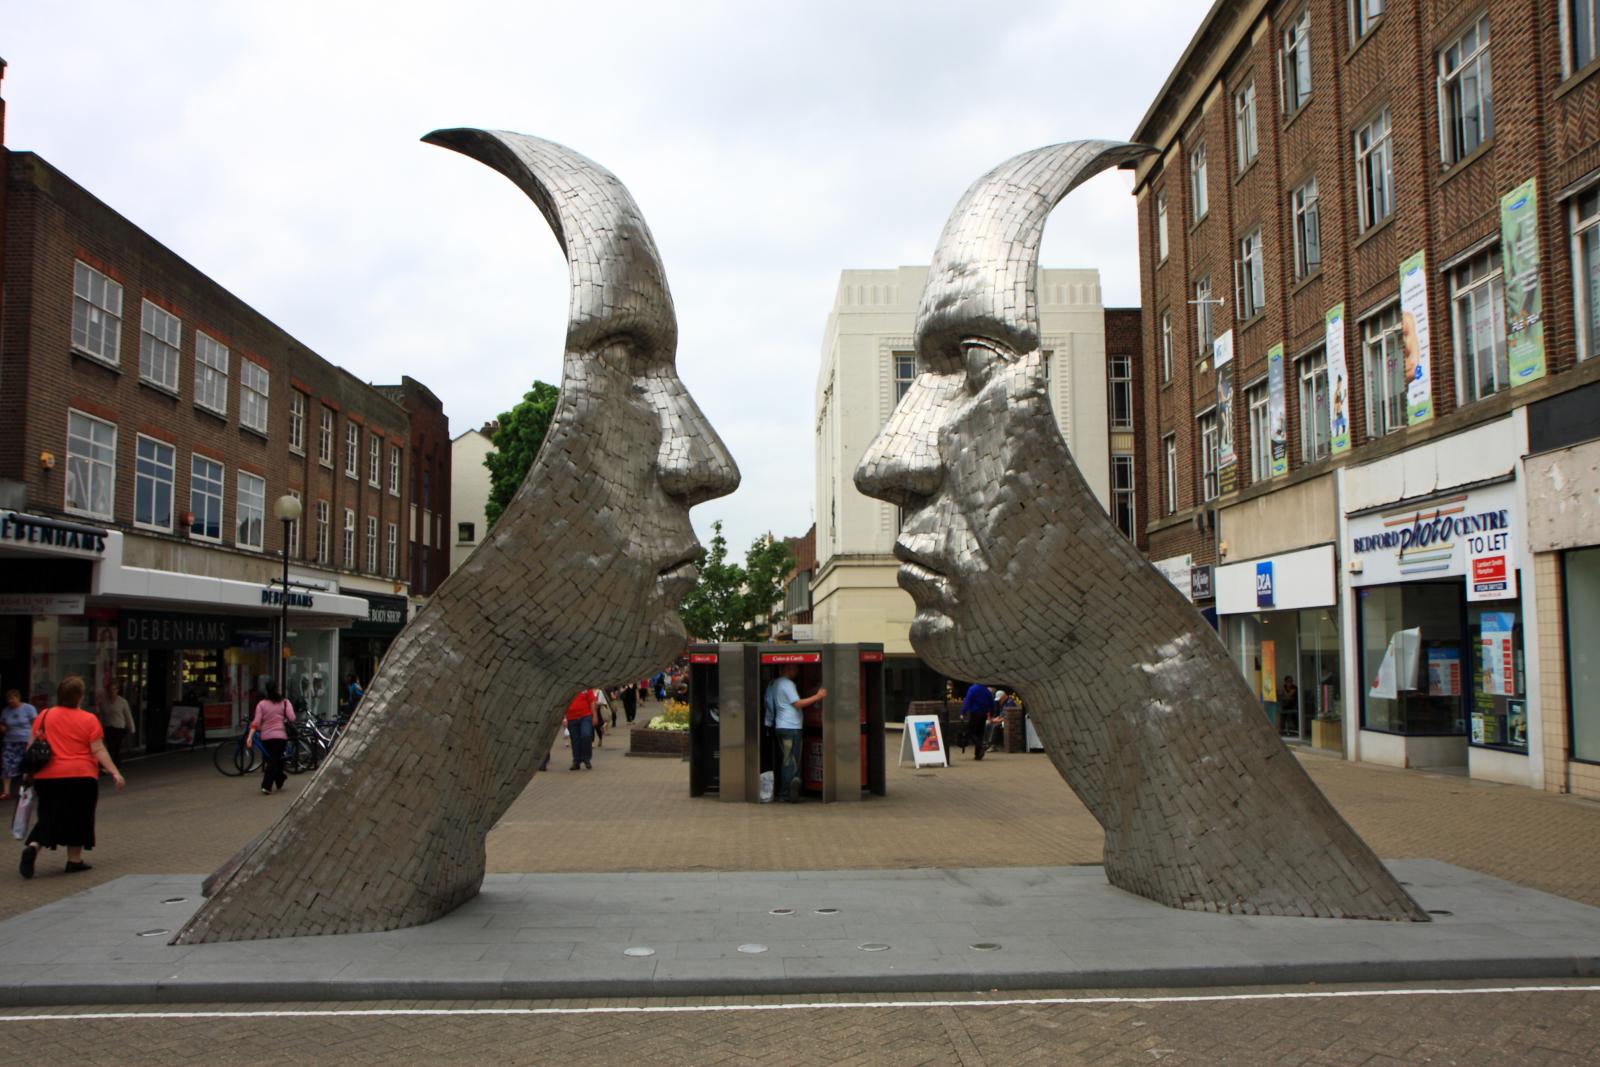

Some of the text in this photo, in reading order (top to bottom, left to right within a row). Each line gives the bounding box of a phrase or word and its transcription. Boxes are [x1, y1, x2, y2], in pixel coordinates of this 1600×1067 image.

[1354, 509, 1508, 559] BEDFORD photo CENTRE
[1467, 533, 1508, 554] TO LET
[372, 609, 386, 623] BODY
[386, 611, 401, 624] SHOP
[127, 618, 226, 641] DEBENHAMS
